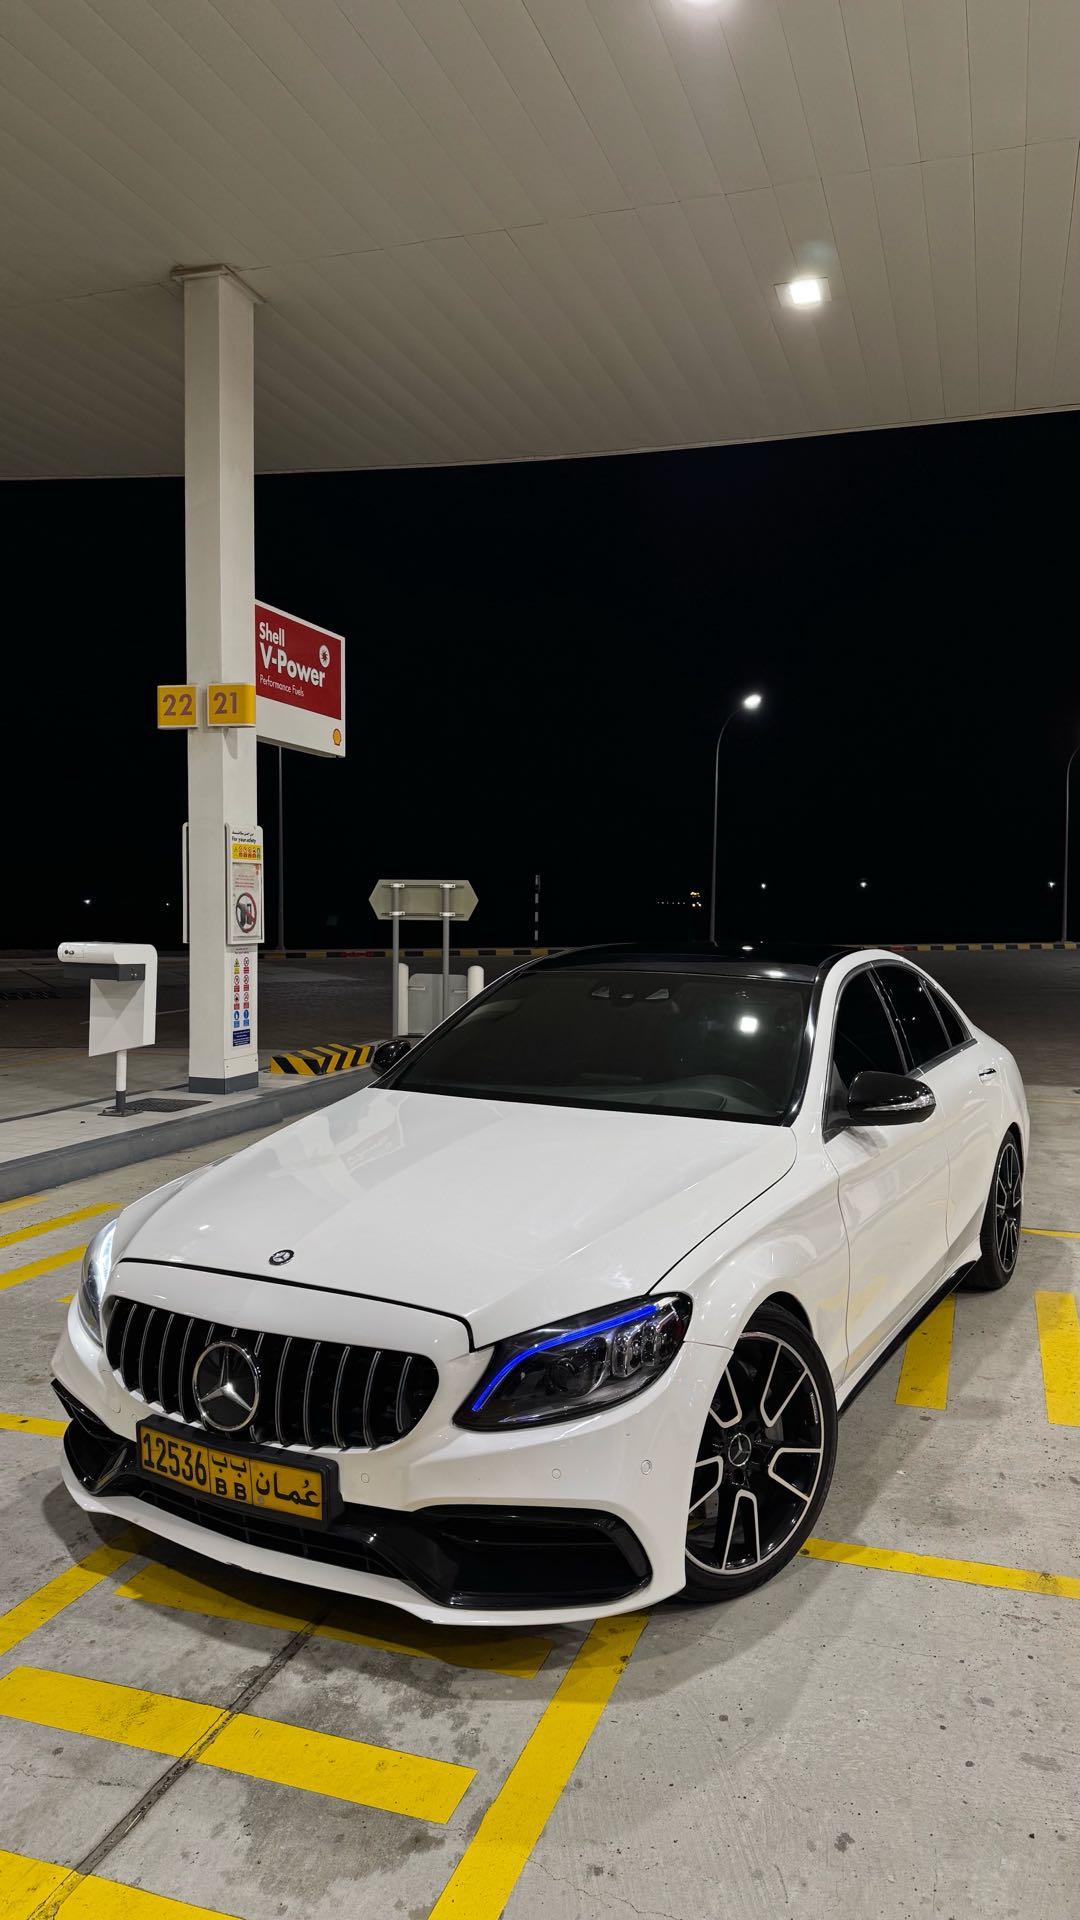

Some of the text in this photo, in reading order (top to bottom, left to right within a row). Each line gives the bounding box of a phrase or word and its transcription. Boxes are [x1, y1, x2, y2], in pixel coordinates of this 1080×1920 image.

[259, 621, 285, 647] Shell
[259, 641, 326, 688] V-Power
[259, 674, 304, 697] Performance Fuels
[162, 693, 193, 716] 22
[213, 691, 237, 715] 21
[143, 1433, 207, 1486] 12536
